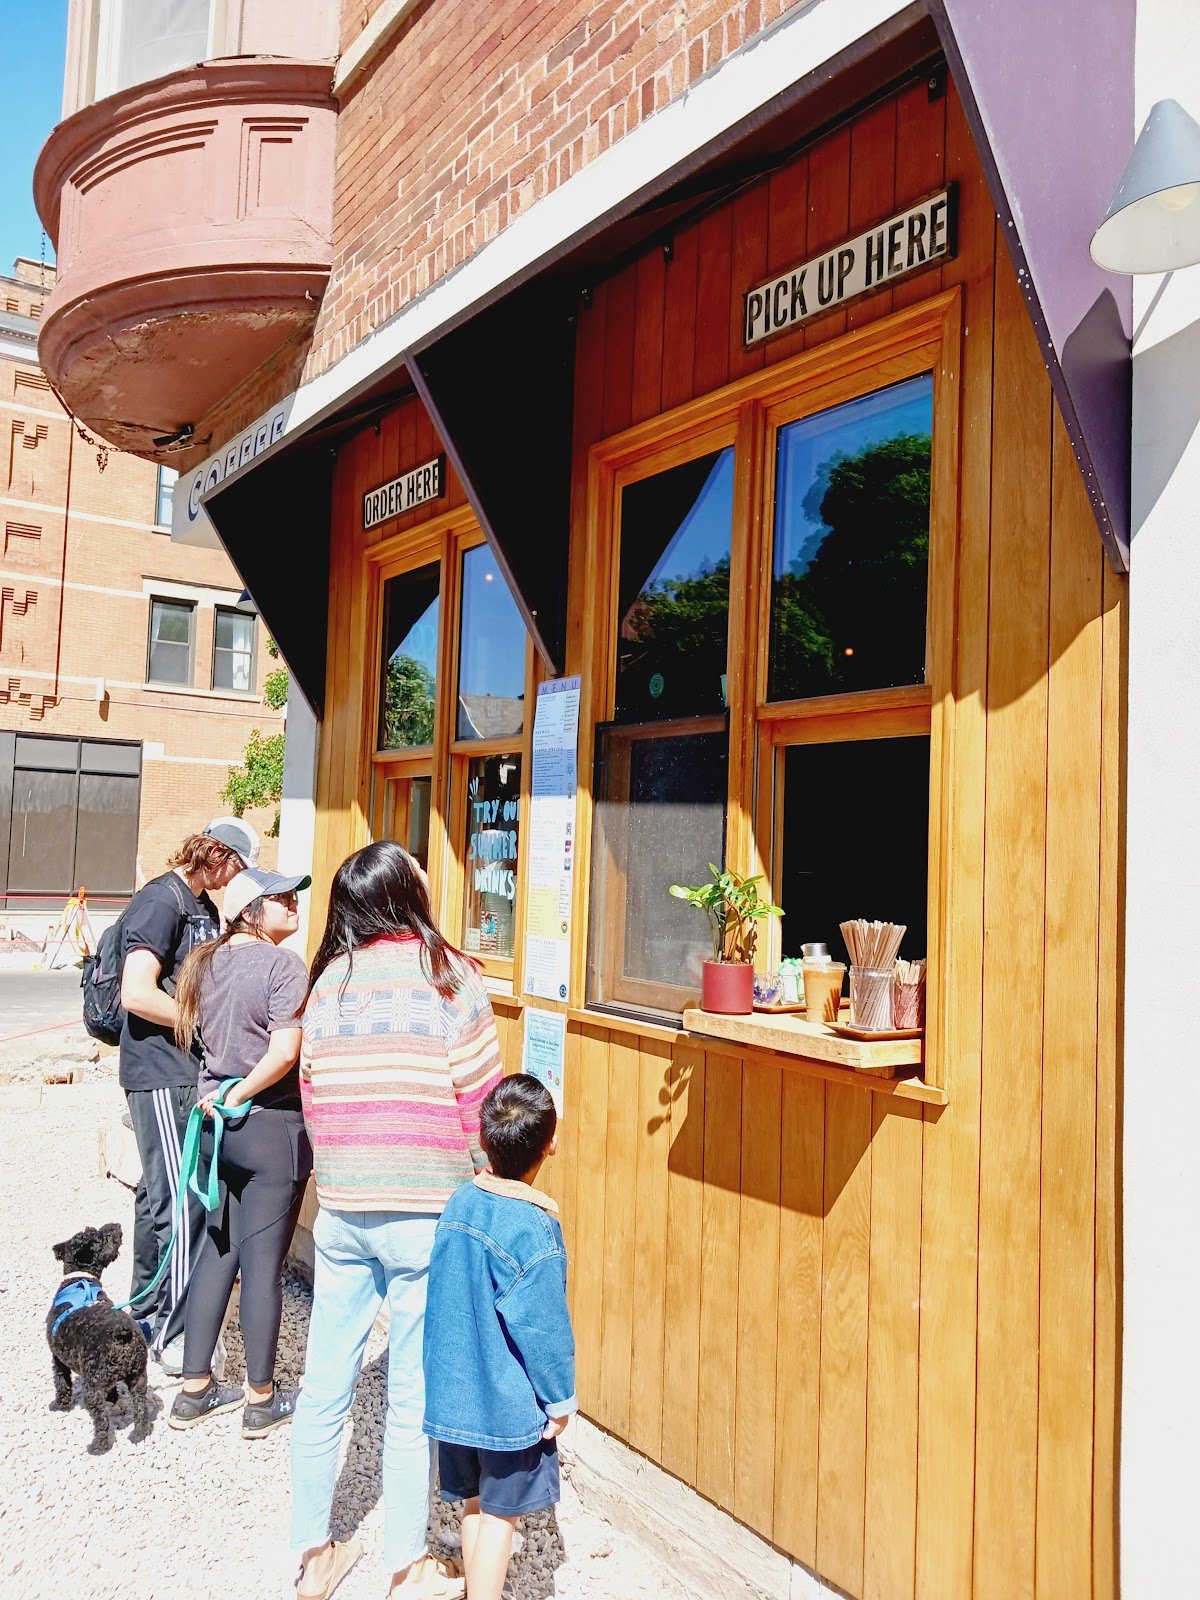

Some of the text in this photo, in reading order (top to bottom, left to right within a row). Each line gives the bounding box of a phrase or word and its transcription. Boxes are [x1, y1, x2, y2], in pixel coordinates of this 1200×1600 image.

[747, 199, 947, 341] PICK UP HERE
[365, 463, 439, 526] ORDER HERE
[541, 680, 577, 695] MENU
[473, 799, 500, 824] TRY
[469, 830, 518, 860] SUMMER
[474, 868, 516, 901] DRINKS
